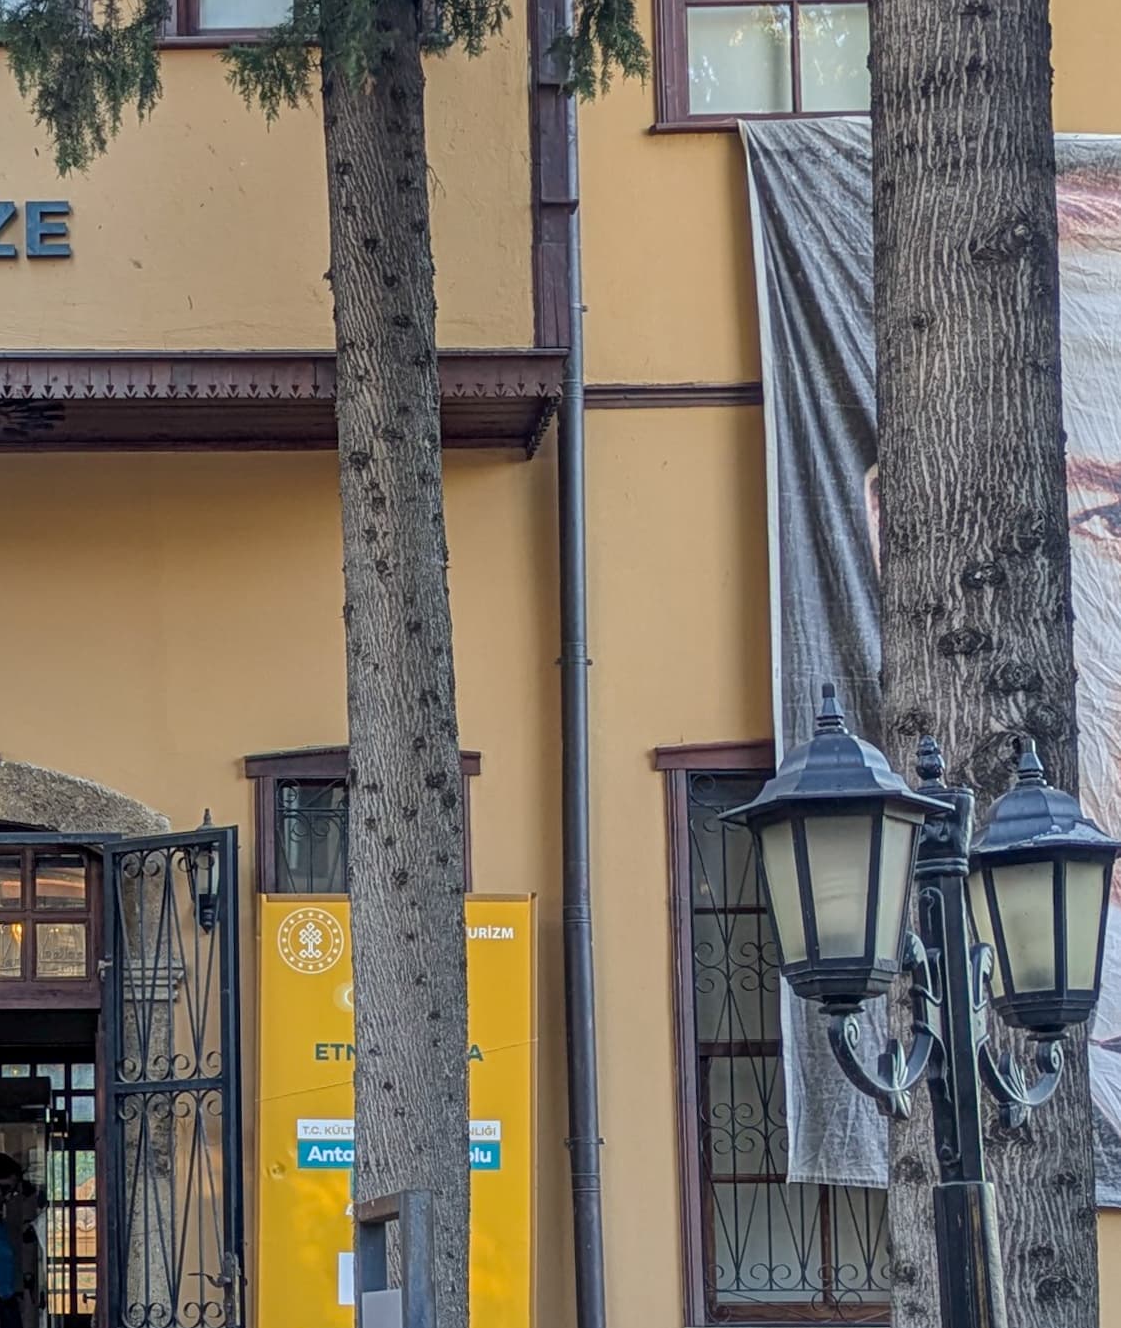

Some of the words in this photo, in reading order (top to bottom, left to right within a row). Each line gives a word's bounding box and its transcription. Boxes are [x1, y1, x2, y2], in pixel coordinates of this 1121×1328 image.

[467, 925, 514, 940] URİZM
[302, 1125, 322, 1136] T.C.
[324, 1123, 352, 1136] KÜLT
[307, 1145, 355, 1162] Anta
